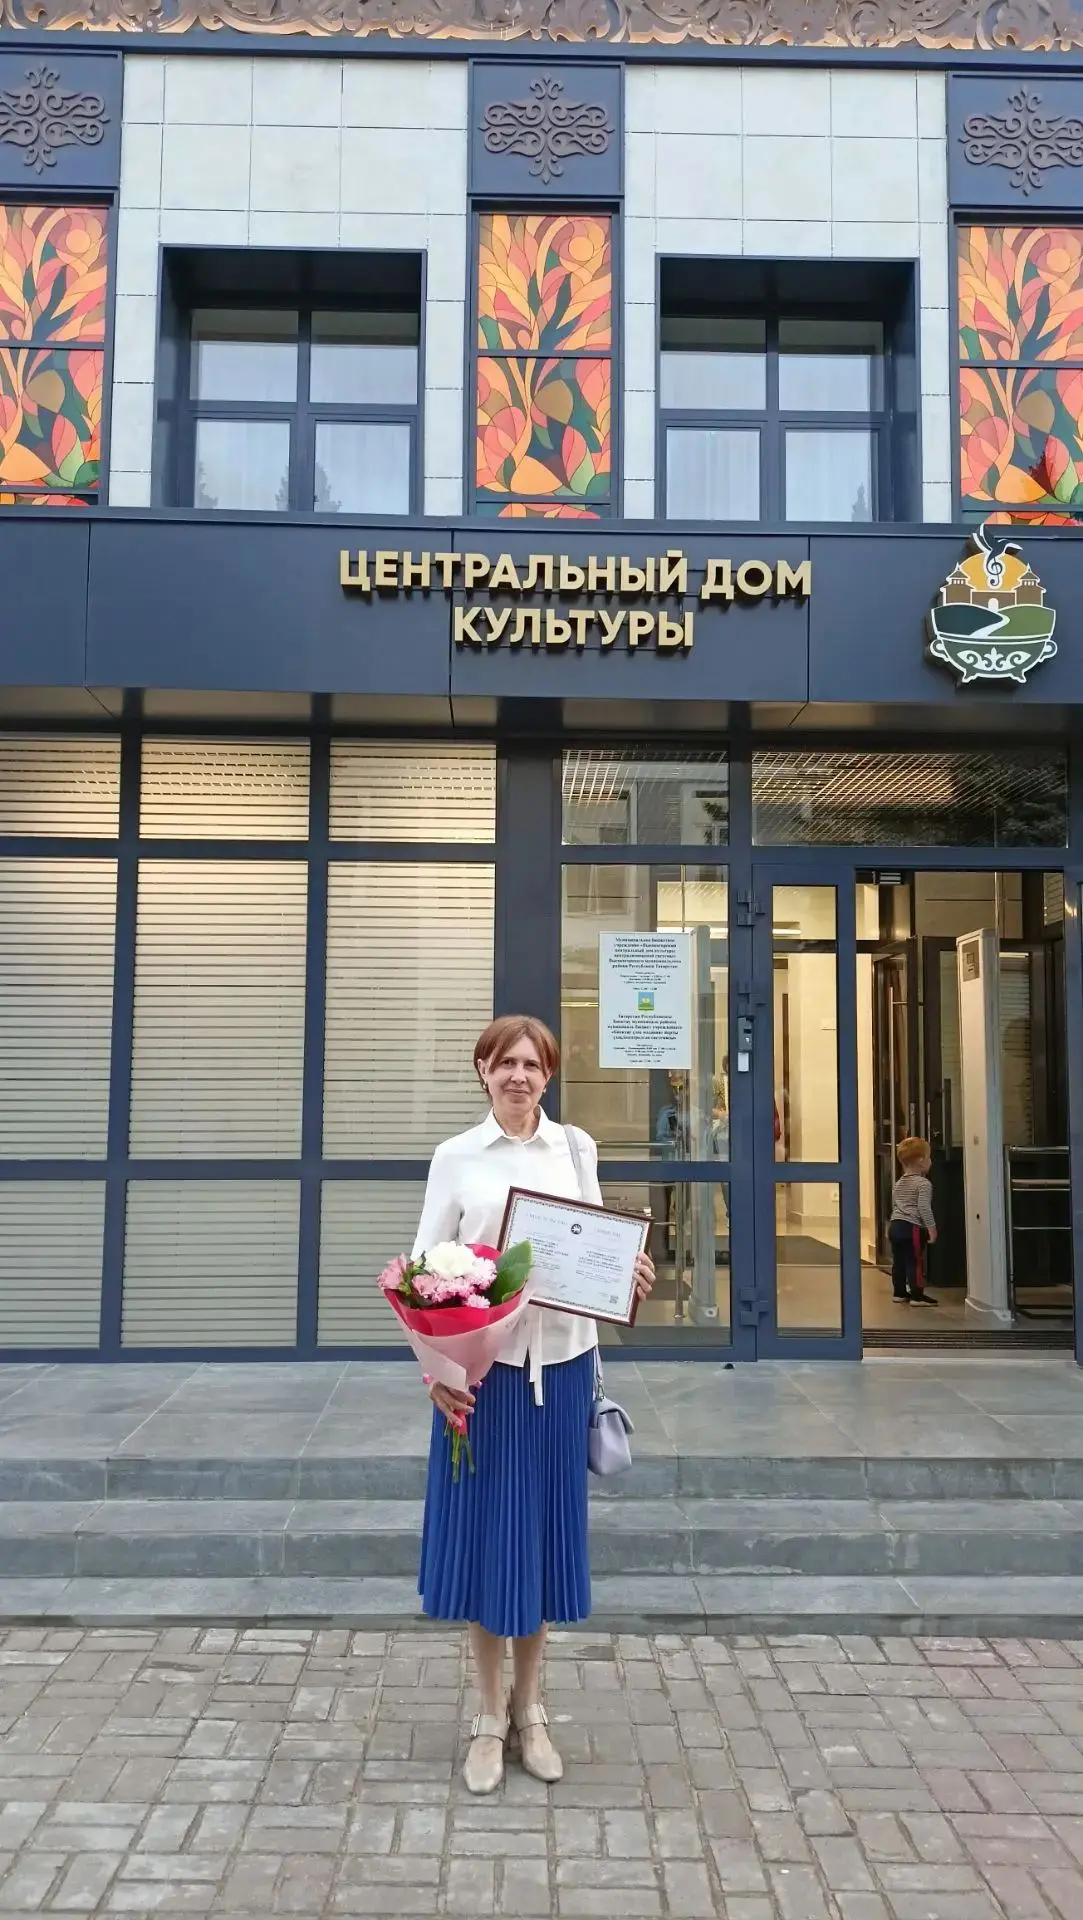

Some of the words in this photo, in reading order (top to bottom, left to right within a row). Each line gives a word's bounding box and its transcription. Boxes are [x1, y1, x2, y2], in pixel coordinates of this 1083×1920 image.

[340, 550, 687, 593] ЦЕНТРАЛЬНЫЙ
[701, 559, 811, 600] ДОМ
[454, 606, 694, 647] КУЛЬТУРЫ
